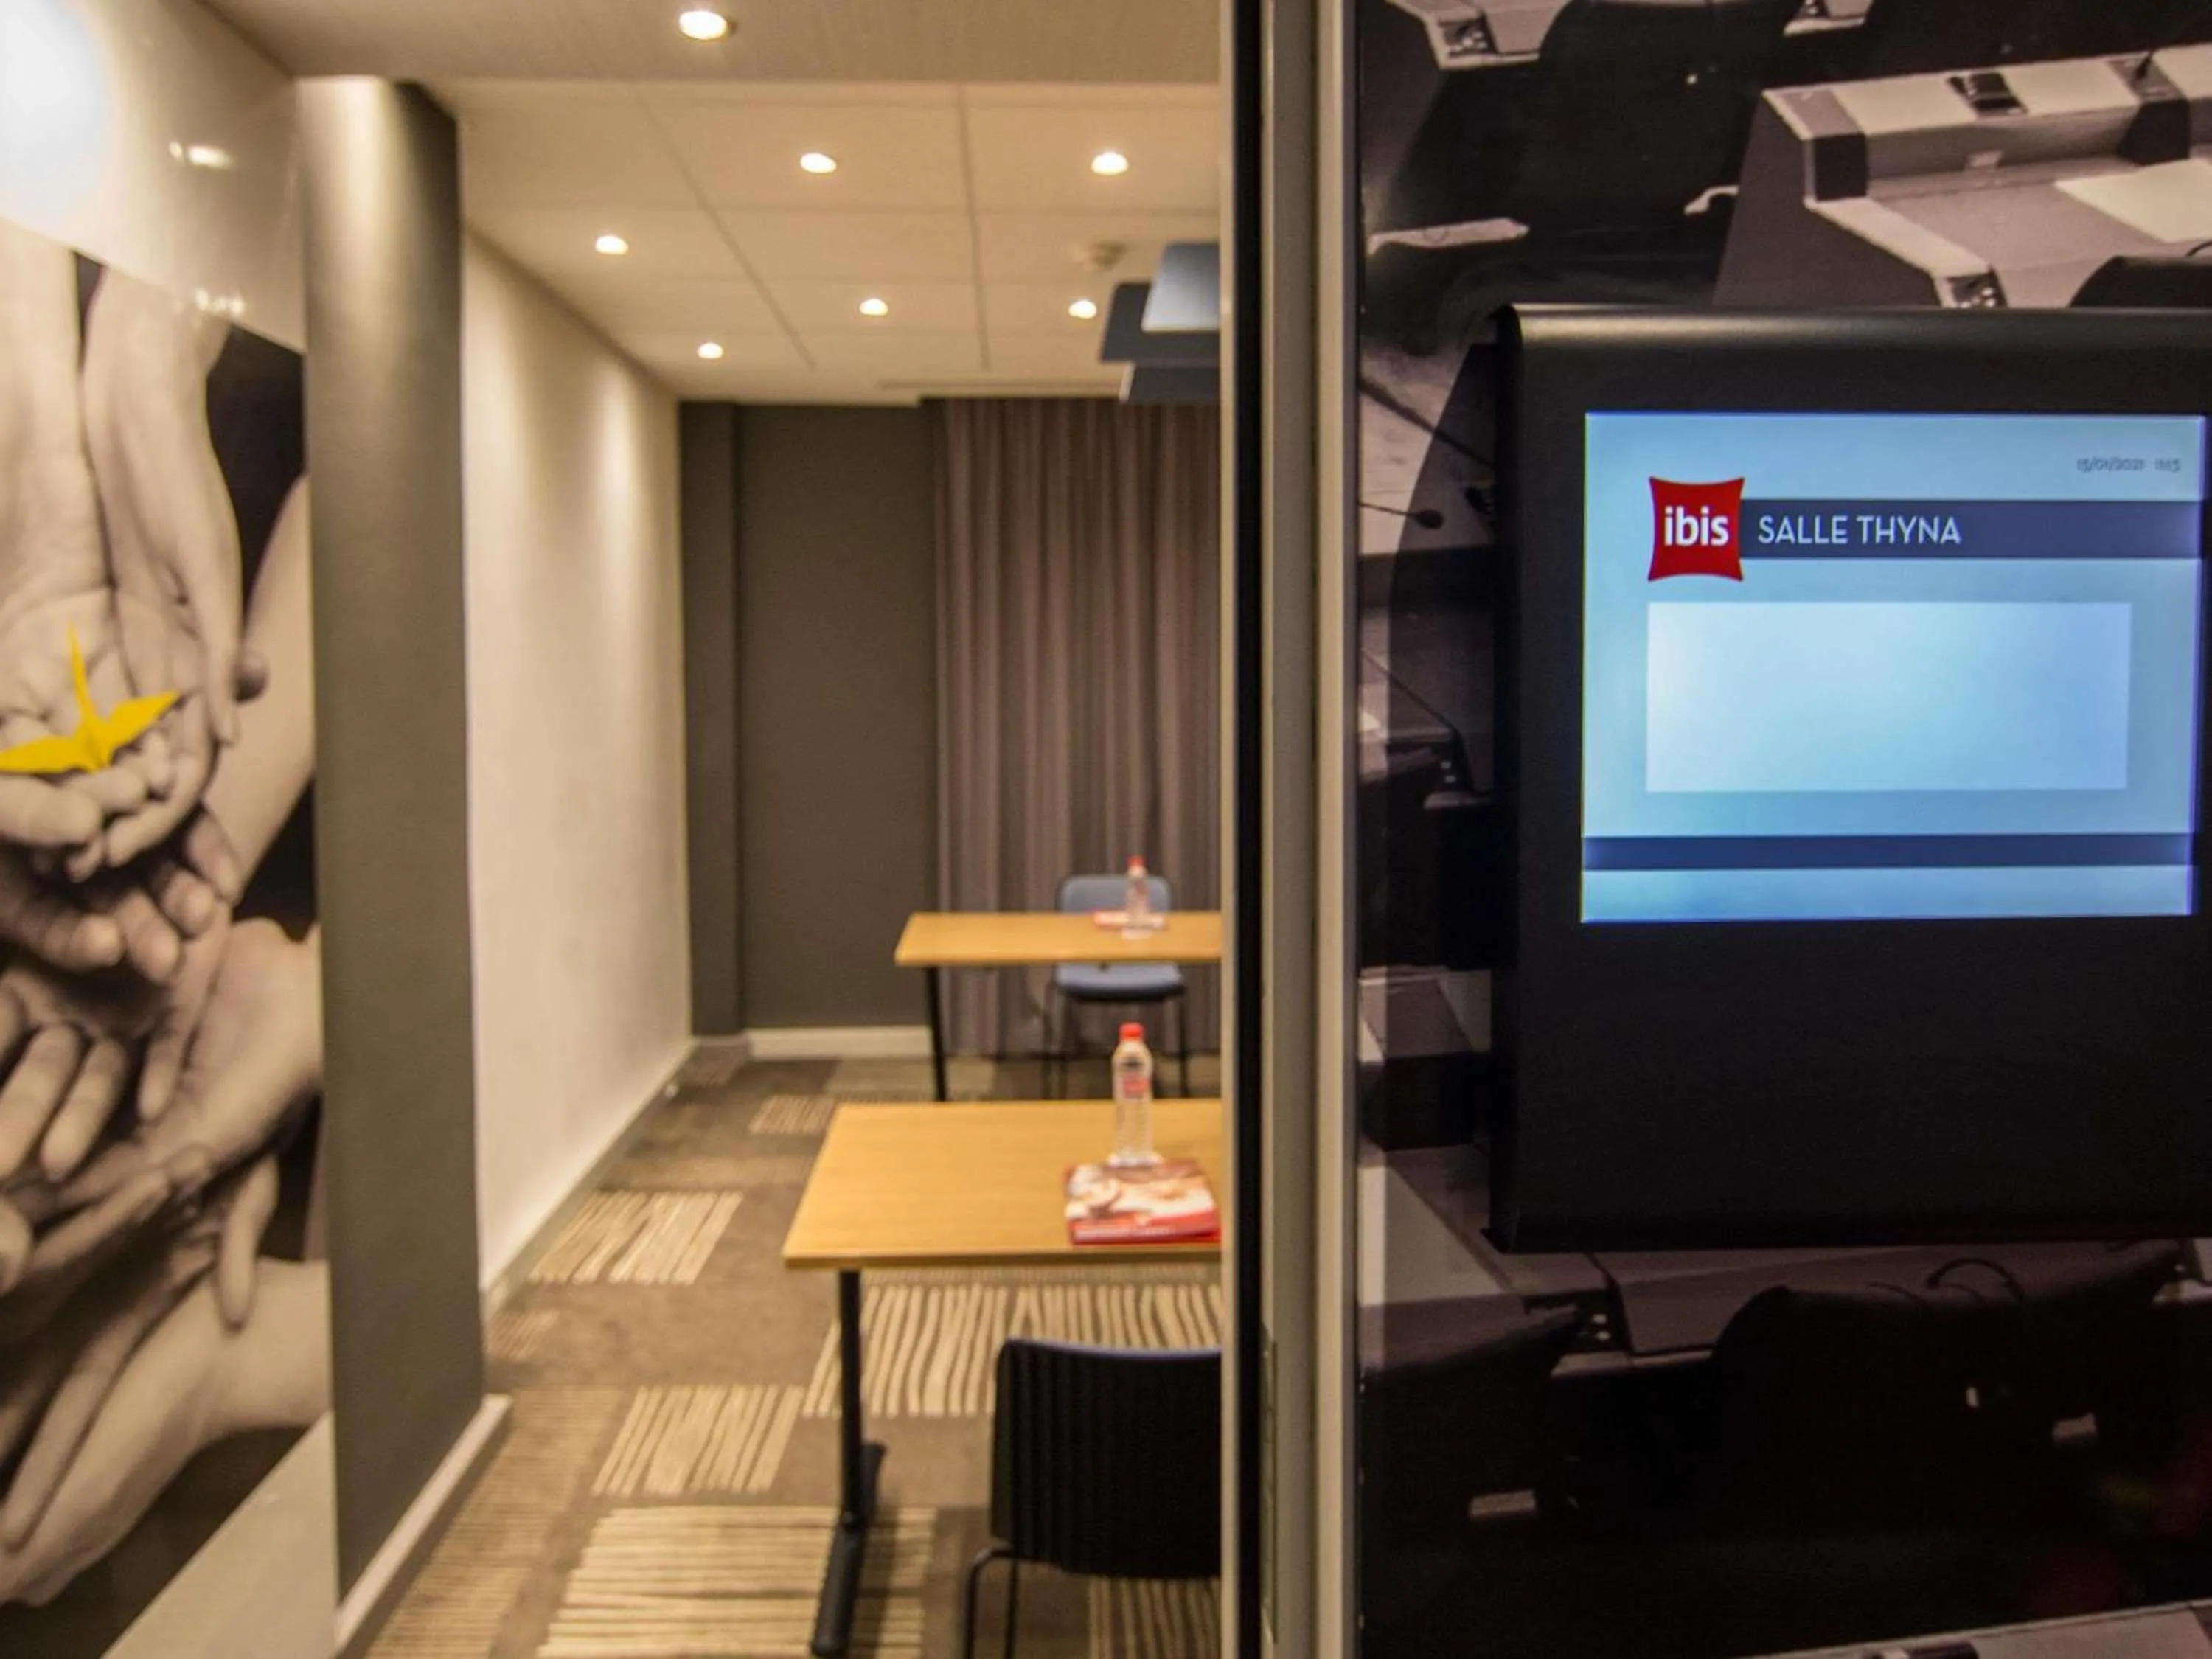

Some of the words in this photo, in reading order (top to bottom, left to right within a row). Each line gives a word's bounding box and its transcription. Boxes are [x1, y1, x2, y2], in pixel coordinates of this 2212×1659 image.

[1663, 505, 1729, 546] ibis
[1758, 515, 1848, 545] SALLE
[1856, 515, 1961, 545] THYNA
